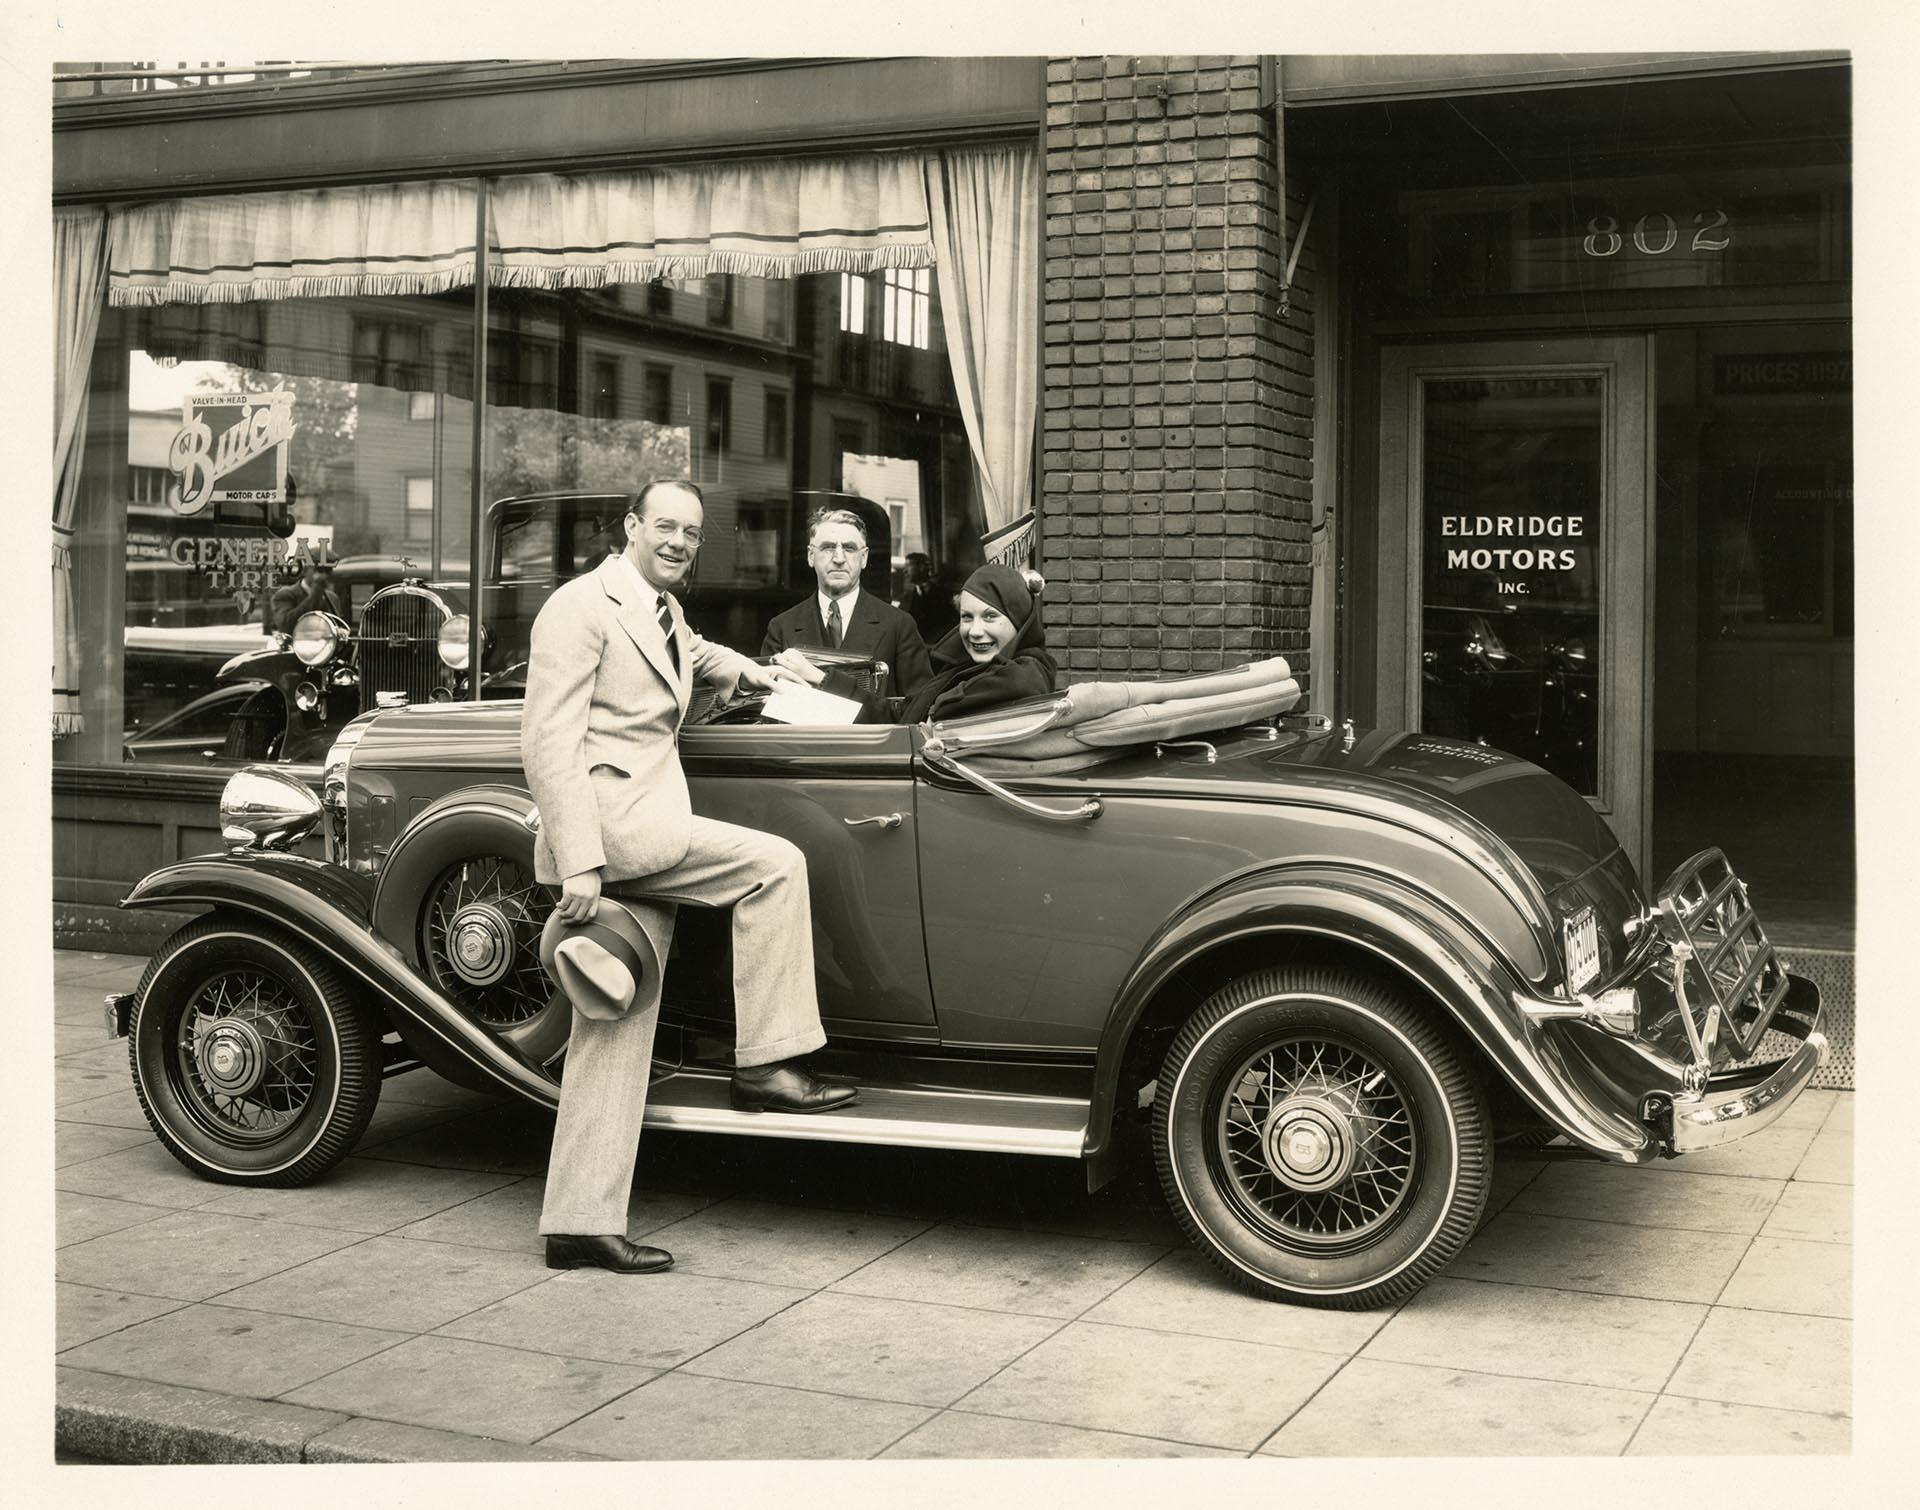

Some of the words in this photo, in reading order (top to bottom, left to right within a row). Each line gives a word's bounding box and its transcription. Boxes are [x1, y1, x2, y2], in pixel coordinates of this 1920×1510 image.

[1582, 208, 1731, 257] 802
[1725, 360, 1800, 385] PRICES
[191, 395, 248, 405] VALVE-IN-HEAD
[168, 380, 298, 517] Buick
[225, 490, 253, 500] MOTOR
[255, 490, 277, 500] CARS
[1440, 515, 1584, 537] ELDRIDGE
[170, 537, 339, 568] GENERAL
[1446, 548, 1576, 571] MOTORS
[205, 570, 282, 589] TIRE
[1497, 582, 1531, 595] INC.
